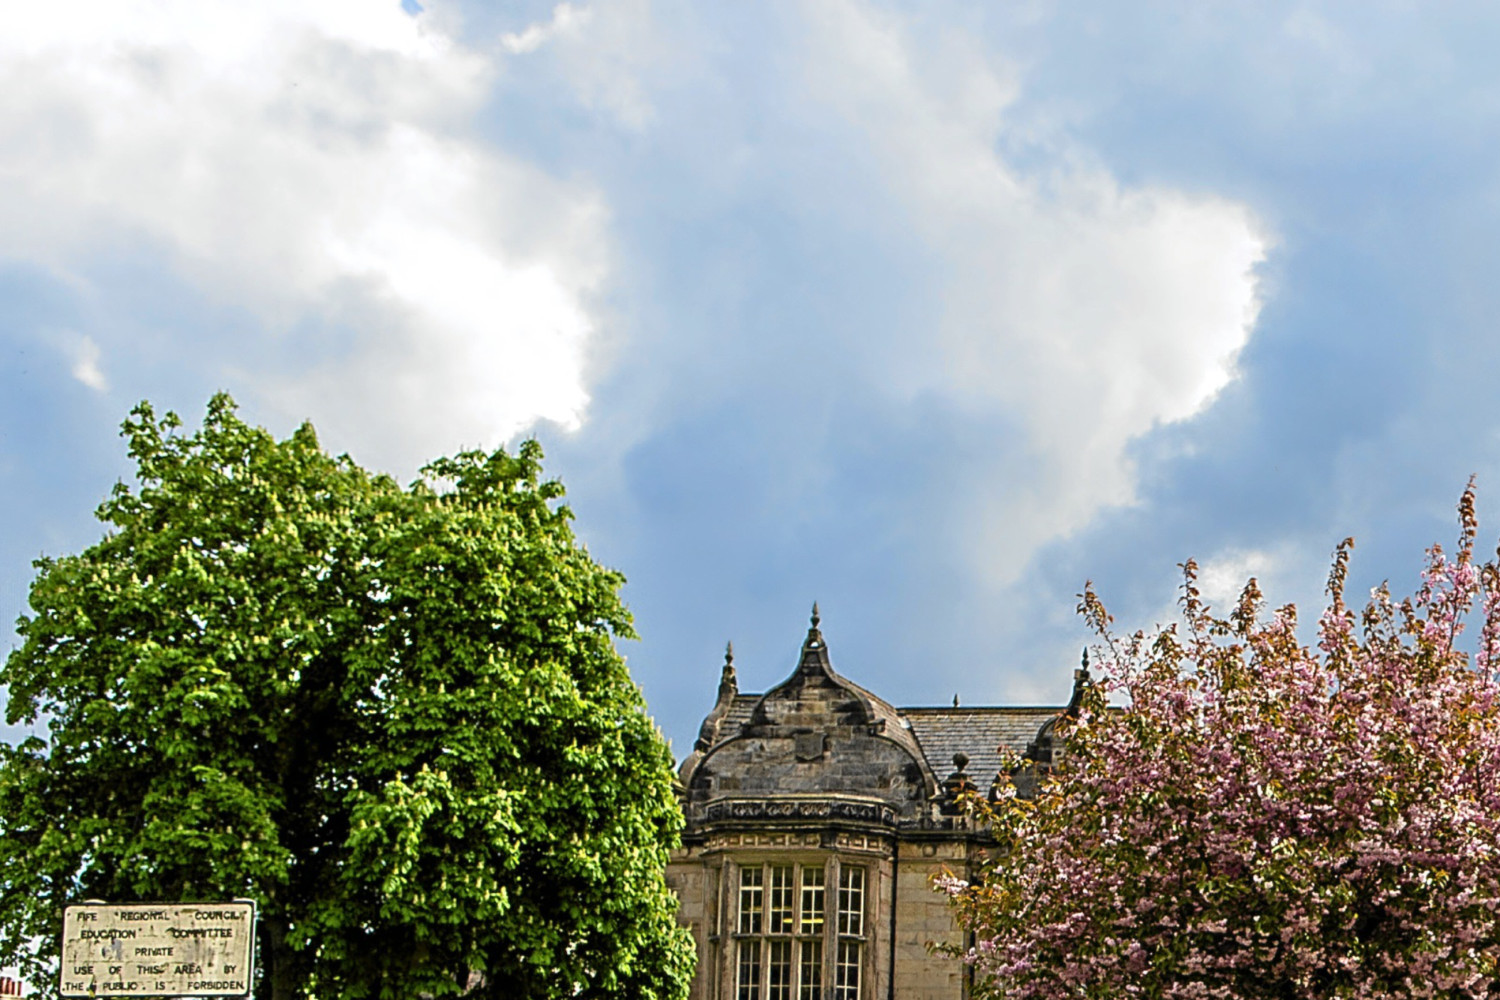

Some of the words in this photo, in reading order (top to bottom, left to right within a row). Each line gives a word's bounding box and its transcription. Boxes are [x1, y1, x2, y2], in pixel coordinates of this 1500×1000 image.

[77, 912, 97, 921] FIFE
[120, 911, 170, 921] REGIONAL
[195, 911, 240, 920] COUNCIL
[81, 929, 136, 939] EDUCATION
[172, 928, 232, 938] COMMITTEE
[135, 947, 173, 956] PRIVATE
[74, 966, 93, 975] USE
[109, 966, 122, 975] OF
[137, 965, 159, 974] THIS
[174, 965, 202, 974] AREA
[224, 965, 236, 974] BY
[65, 982, 84, 991] THE
[103, 982, 138, 991] PUBLIC
[155, 981, 166, 990] IS
[188, 981, 245, 990] FORBIDDEN
